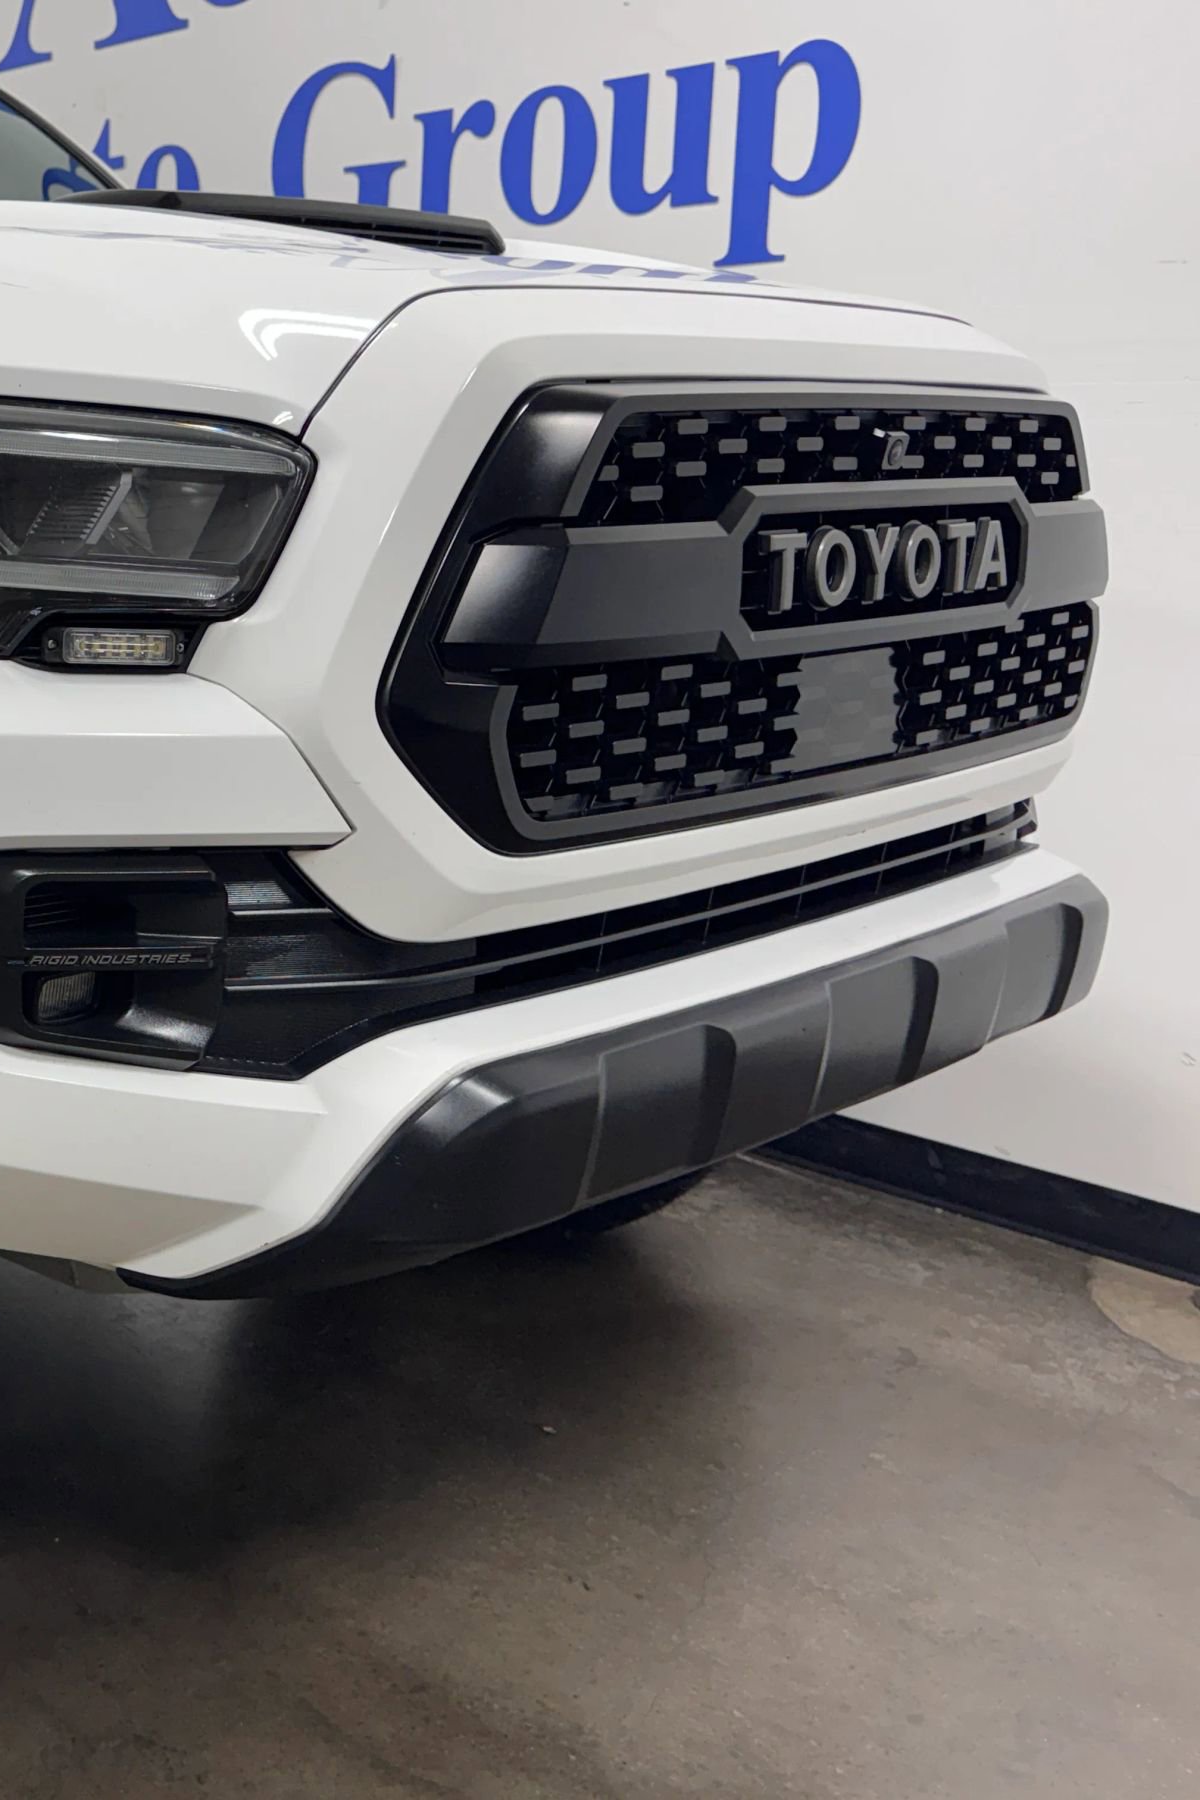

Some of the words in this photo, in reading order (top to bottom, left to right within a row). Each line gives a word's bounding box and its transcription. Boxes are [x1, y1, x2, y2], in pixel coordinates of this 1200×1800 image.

[271, 37, 862, 267] Group
[758, 516, 1008, 616] TOYOTA
[29, 954, 79, 966] RIGID
[81, 953, 192, 965] INDUSTRIES
